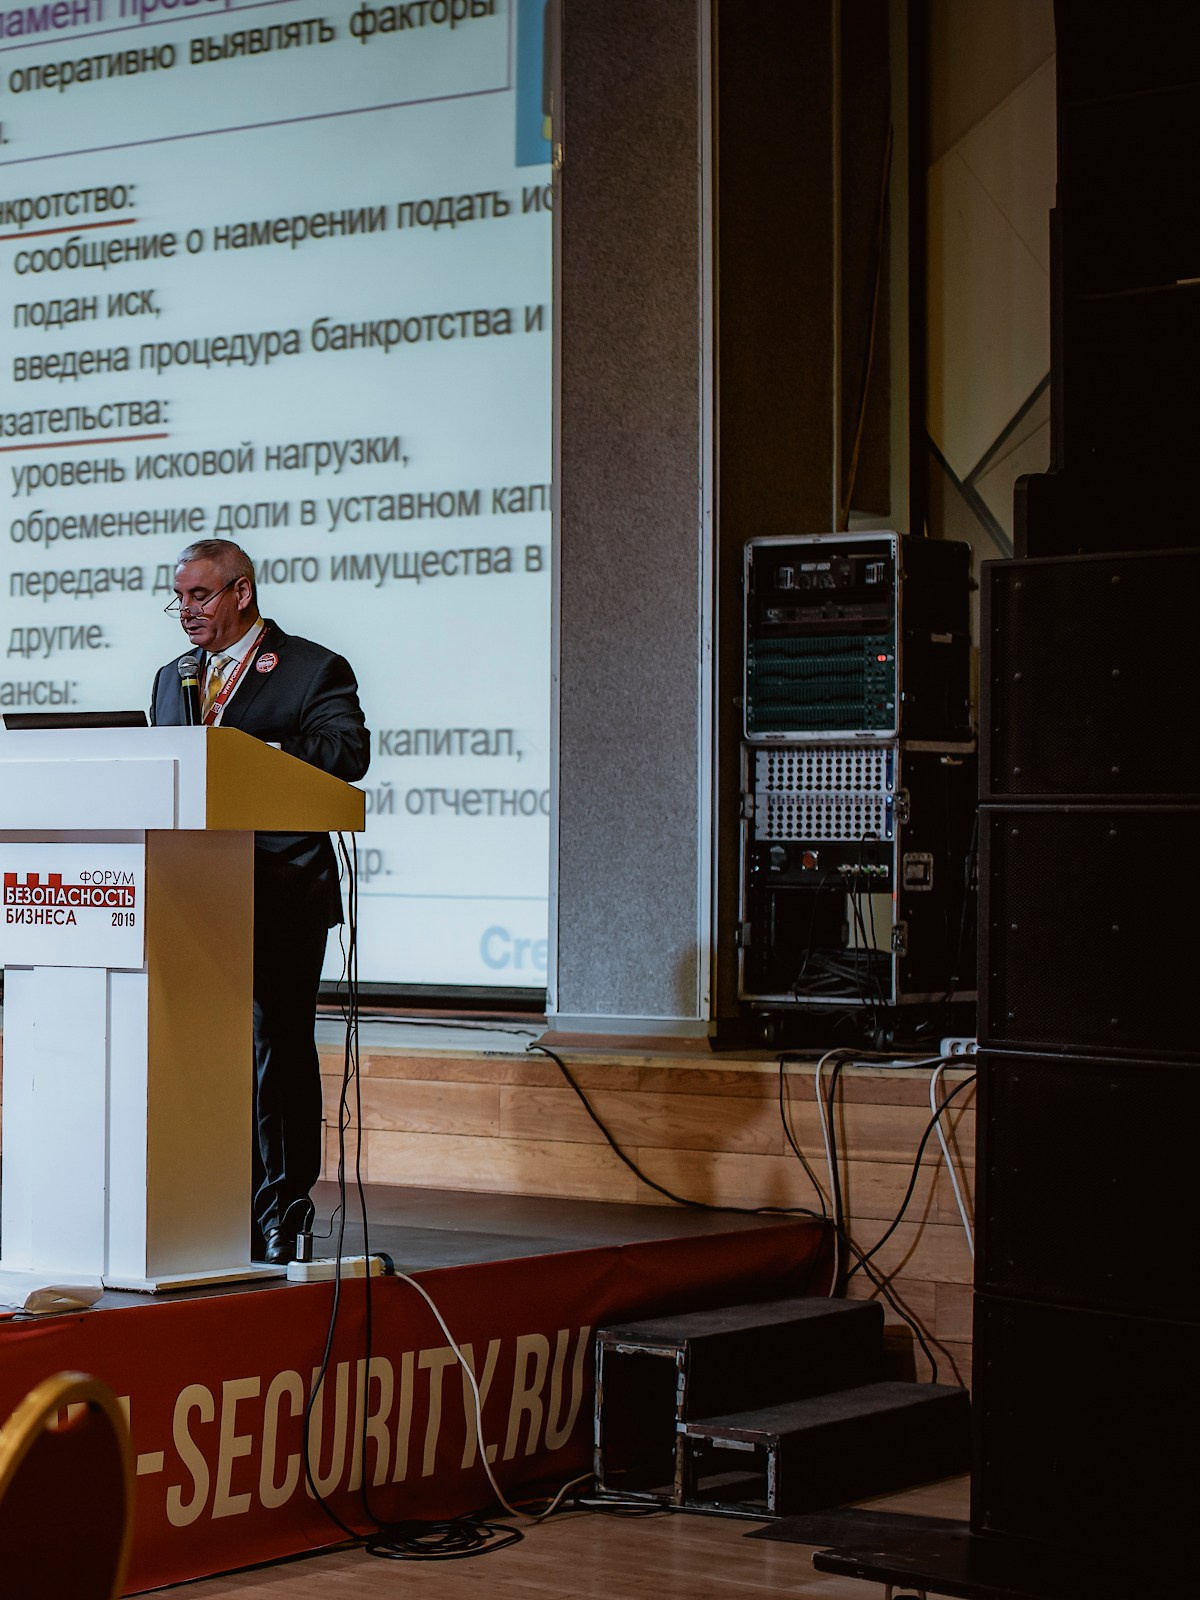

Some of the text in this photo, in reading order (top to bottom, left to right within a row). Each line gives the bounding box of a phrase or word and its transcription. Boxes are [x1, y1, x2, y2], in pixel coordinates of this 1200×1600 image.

[8, 43, 176, 94] оперативно
[189, 19, 335, 66] выявлять
[349, 0, 498, 44] факторы
[13, 231, 177, 275] сообщение
[185, 227, 205, 255] о
[213, 204, 388, 251] намерении
[396, 189, 512, 231] подать
[13, 288, 162, 332] подан иск,
[13, 304, 544, 383] введена процедура банкротства и
[11, 434, 410, 497] уровень исковой нагрузки,
[10, 484, 552, 549] обременение доли в уставном кап
[10, 566, 144, 603] передача
[330, 546, 512, 583] имущества
[524, 544, 543, 573] в
[7, 622, 112, 659] другие.
[377, 727, 523, 763] капитал,
[6, 886, 135, 908] БЕЗОПАСНОСТЬ
[79, 870, 135, 885] ФОРУМ
[6, 908, 136, 927] БИЗНЕСА 2019
